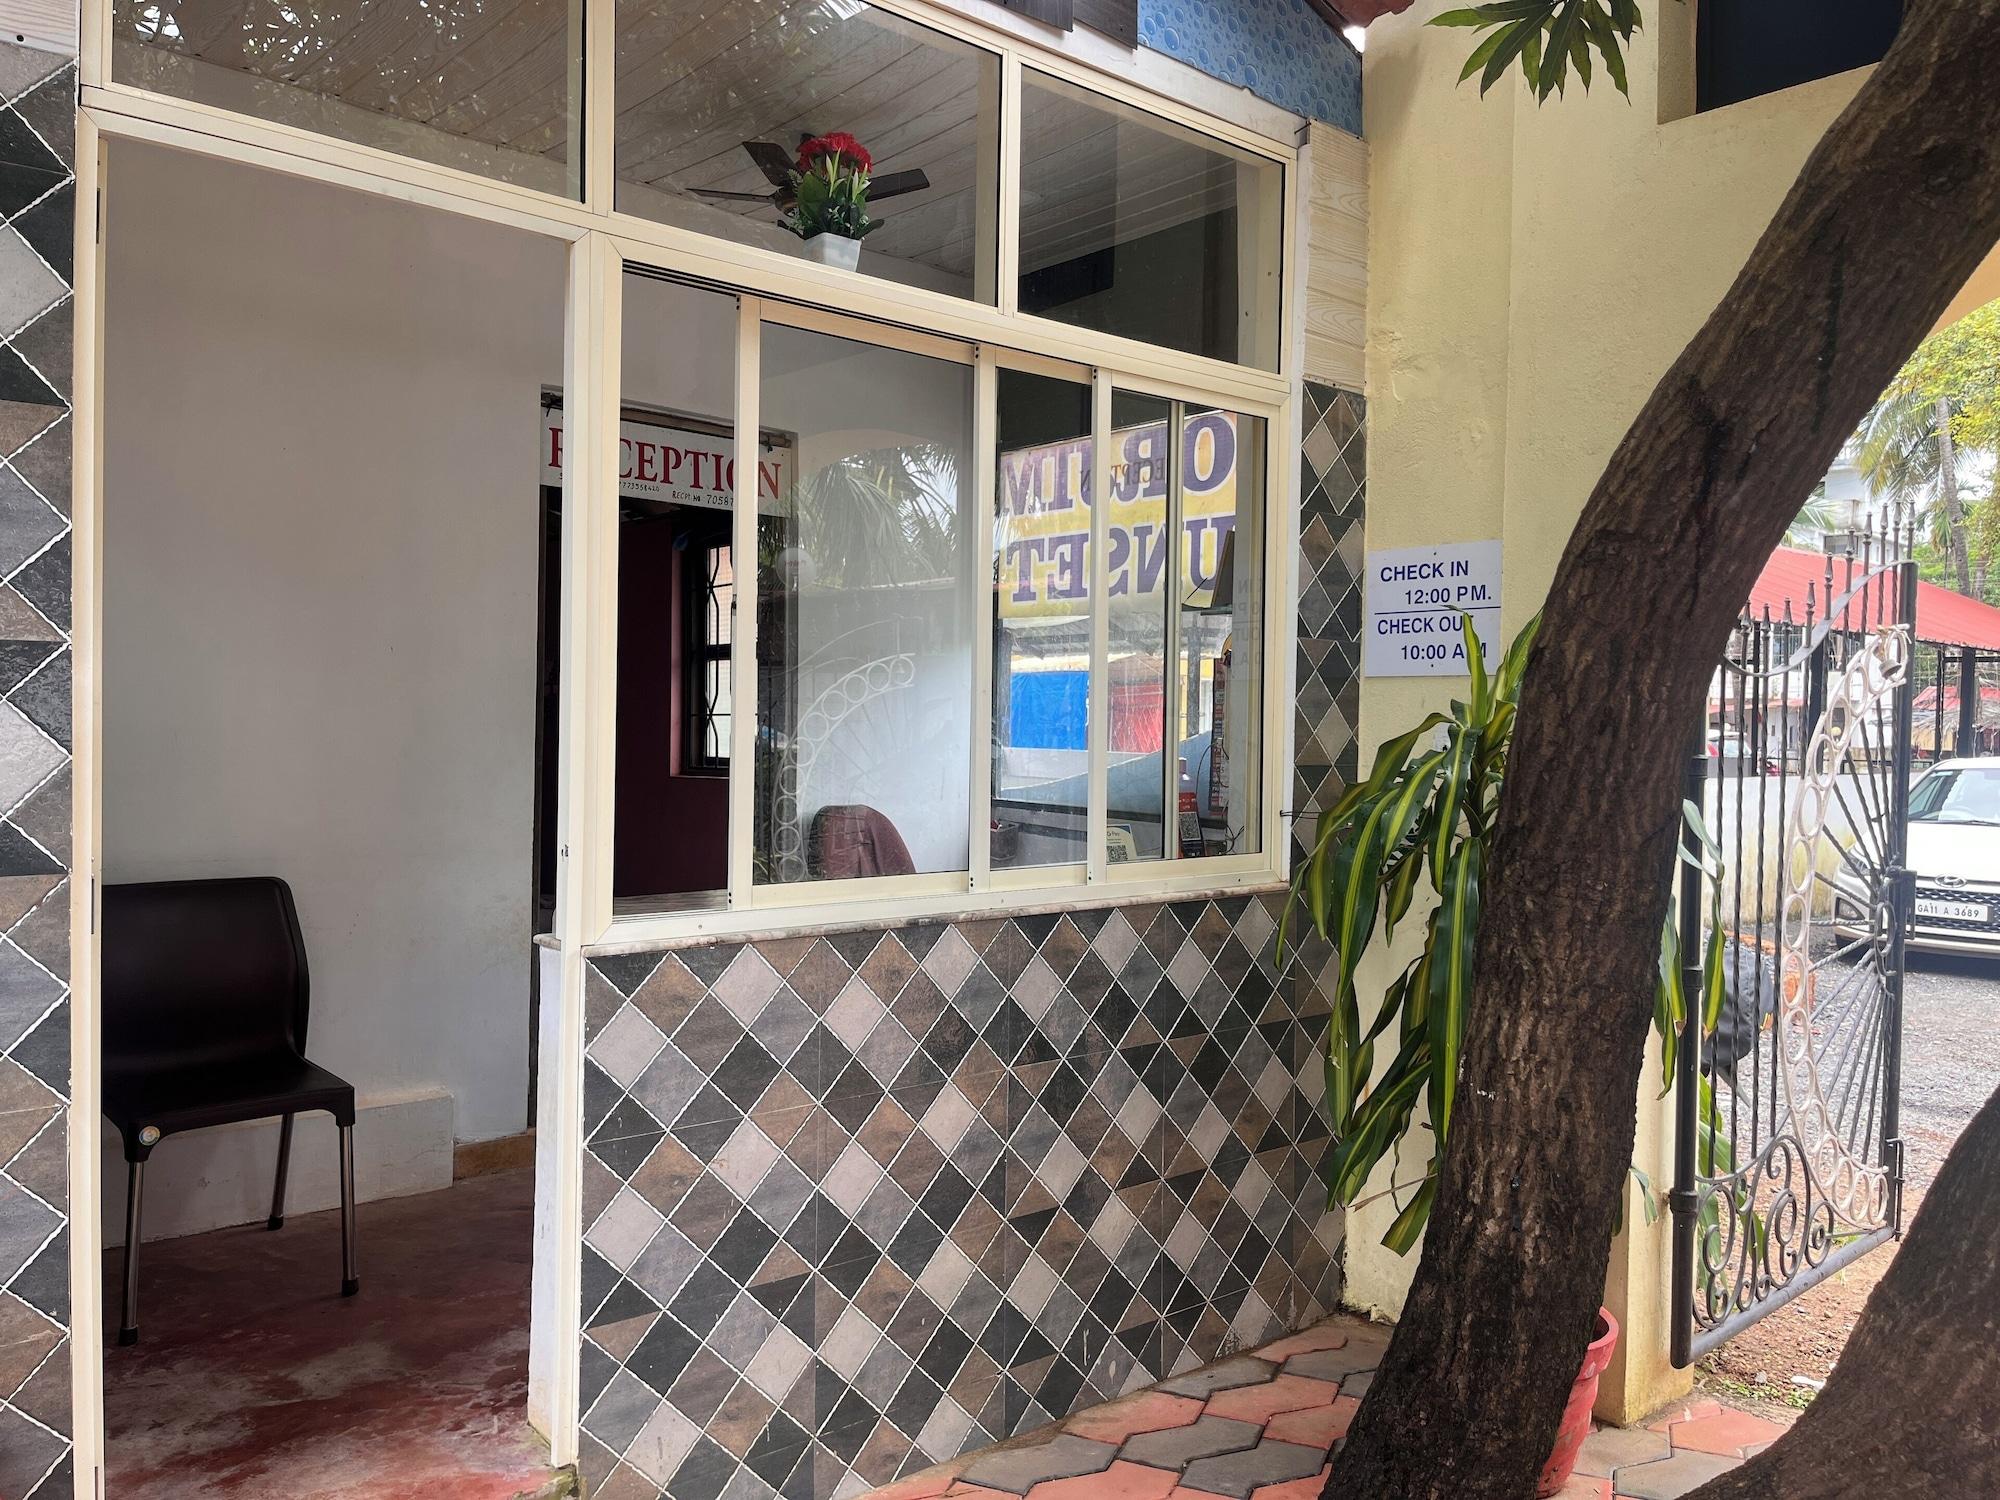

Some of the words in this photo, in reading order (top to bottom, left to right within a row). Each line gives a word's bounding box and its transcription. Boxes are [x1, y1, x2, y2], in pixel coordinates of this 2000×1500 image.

[1380, 562, 1444, 582] CHECK
[1450, 560, 1469, 577] IN
[1405, 588, 1450, 605] 12:00
[1377, 618, 1434, 635] CHECK
[1439, 615, 1474, 632] OU
[1401, 644, 1446, 660] 10:00
[1917, 904, 1938, 914] GA11
[1943, 907, 1949, 915] A
[1954, 907, 1979, 918] 3689
